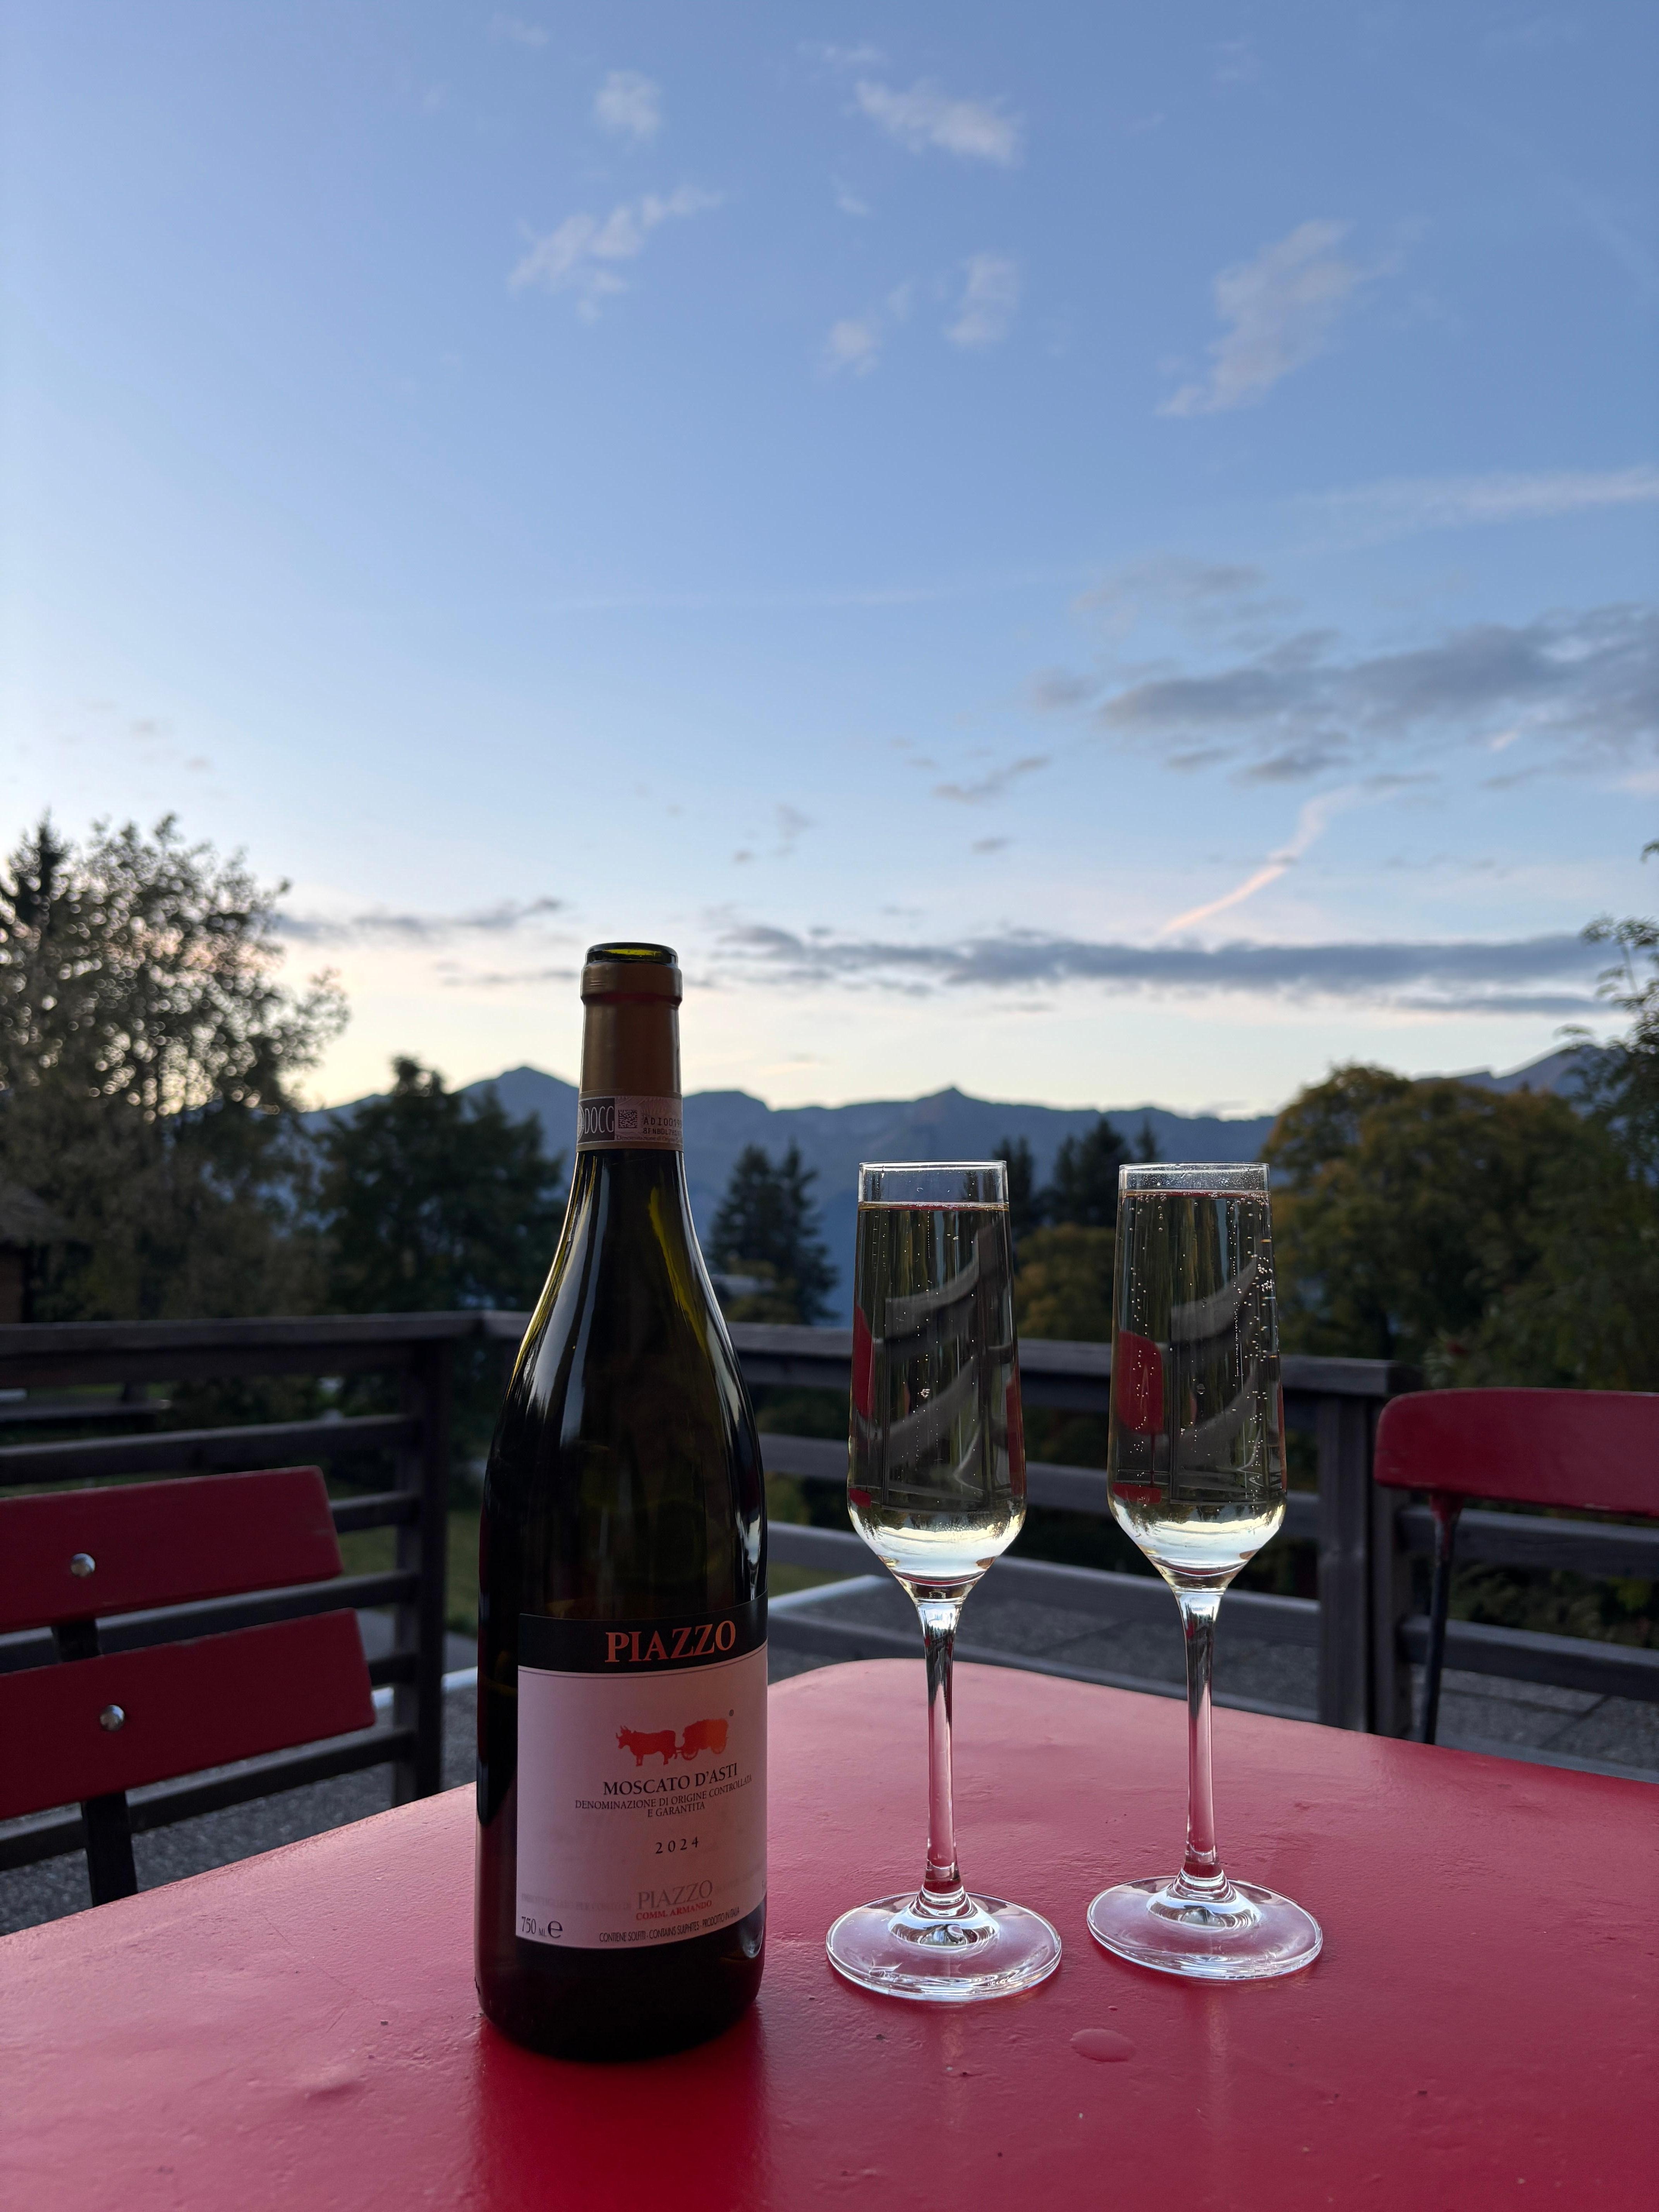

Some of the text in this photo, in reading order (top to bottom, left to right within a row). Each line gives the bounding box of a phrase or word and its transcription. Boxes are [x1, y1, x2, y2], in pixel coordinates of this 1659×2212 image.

[584, 1105, 614, 1134] DOCG
[605, 1620, 736, 1662] PIAZZO
[575, 1774, 752, 1809] DENOMINAZIONE DI ORIGINE CONTROLLATA
[603, 1762, 737, 1795] MOSCATO D'ASTI
[647, 1801, 706, 1817] E GARANTITA
[635, 1899, 712, 1921] COMM. ARMANDO
[637, 1879, 713, 1910] PIAZZO
[521, 1916, 537, 1935] 750
[599, 1932, 627, 1942] CONTIENE
[628, 1930, 646, 1941] SOLFITI
[649, 1926, 676, 1939] CONTAINS
[677, 1921, 700, 1935] SULPHITES
[702, 1912, 725, 1928] PRODOTTO
[725, 1911, 730, 1920] IN
